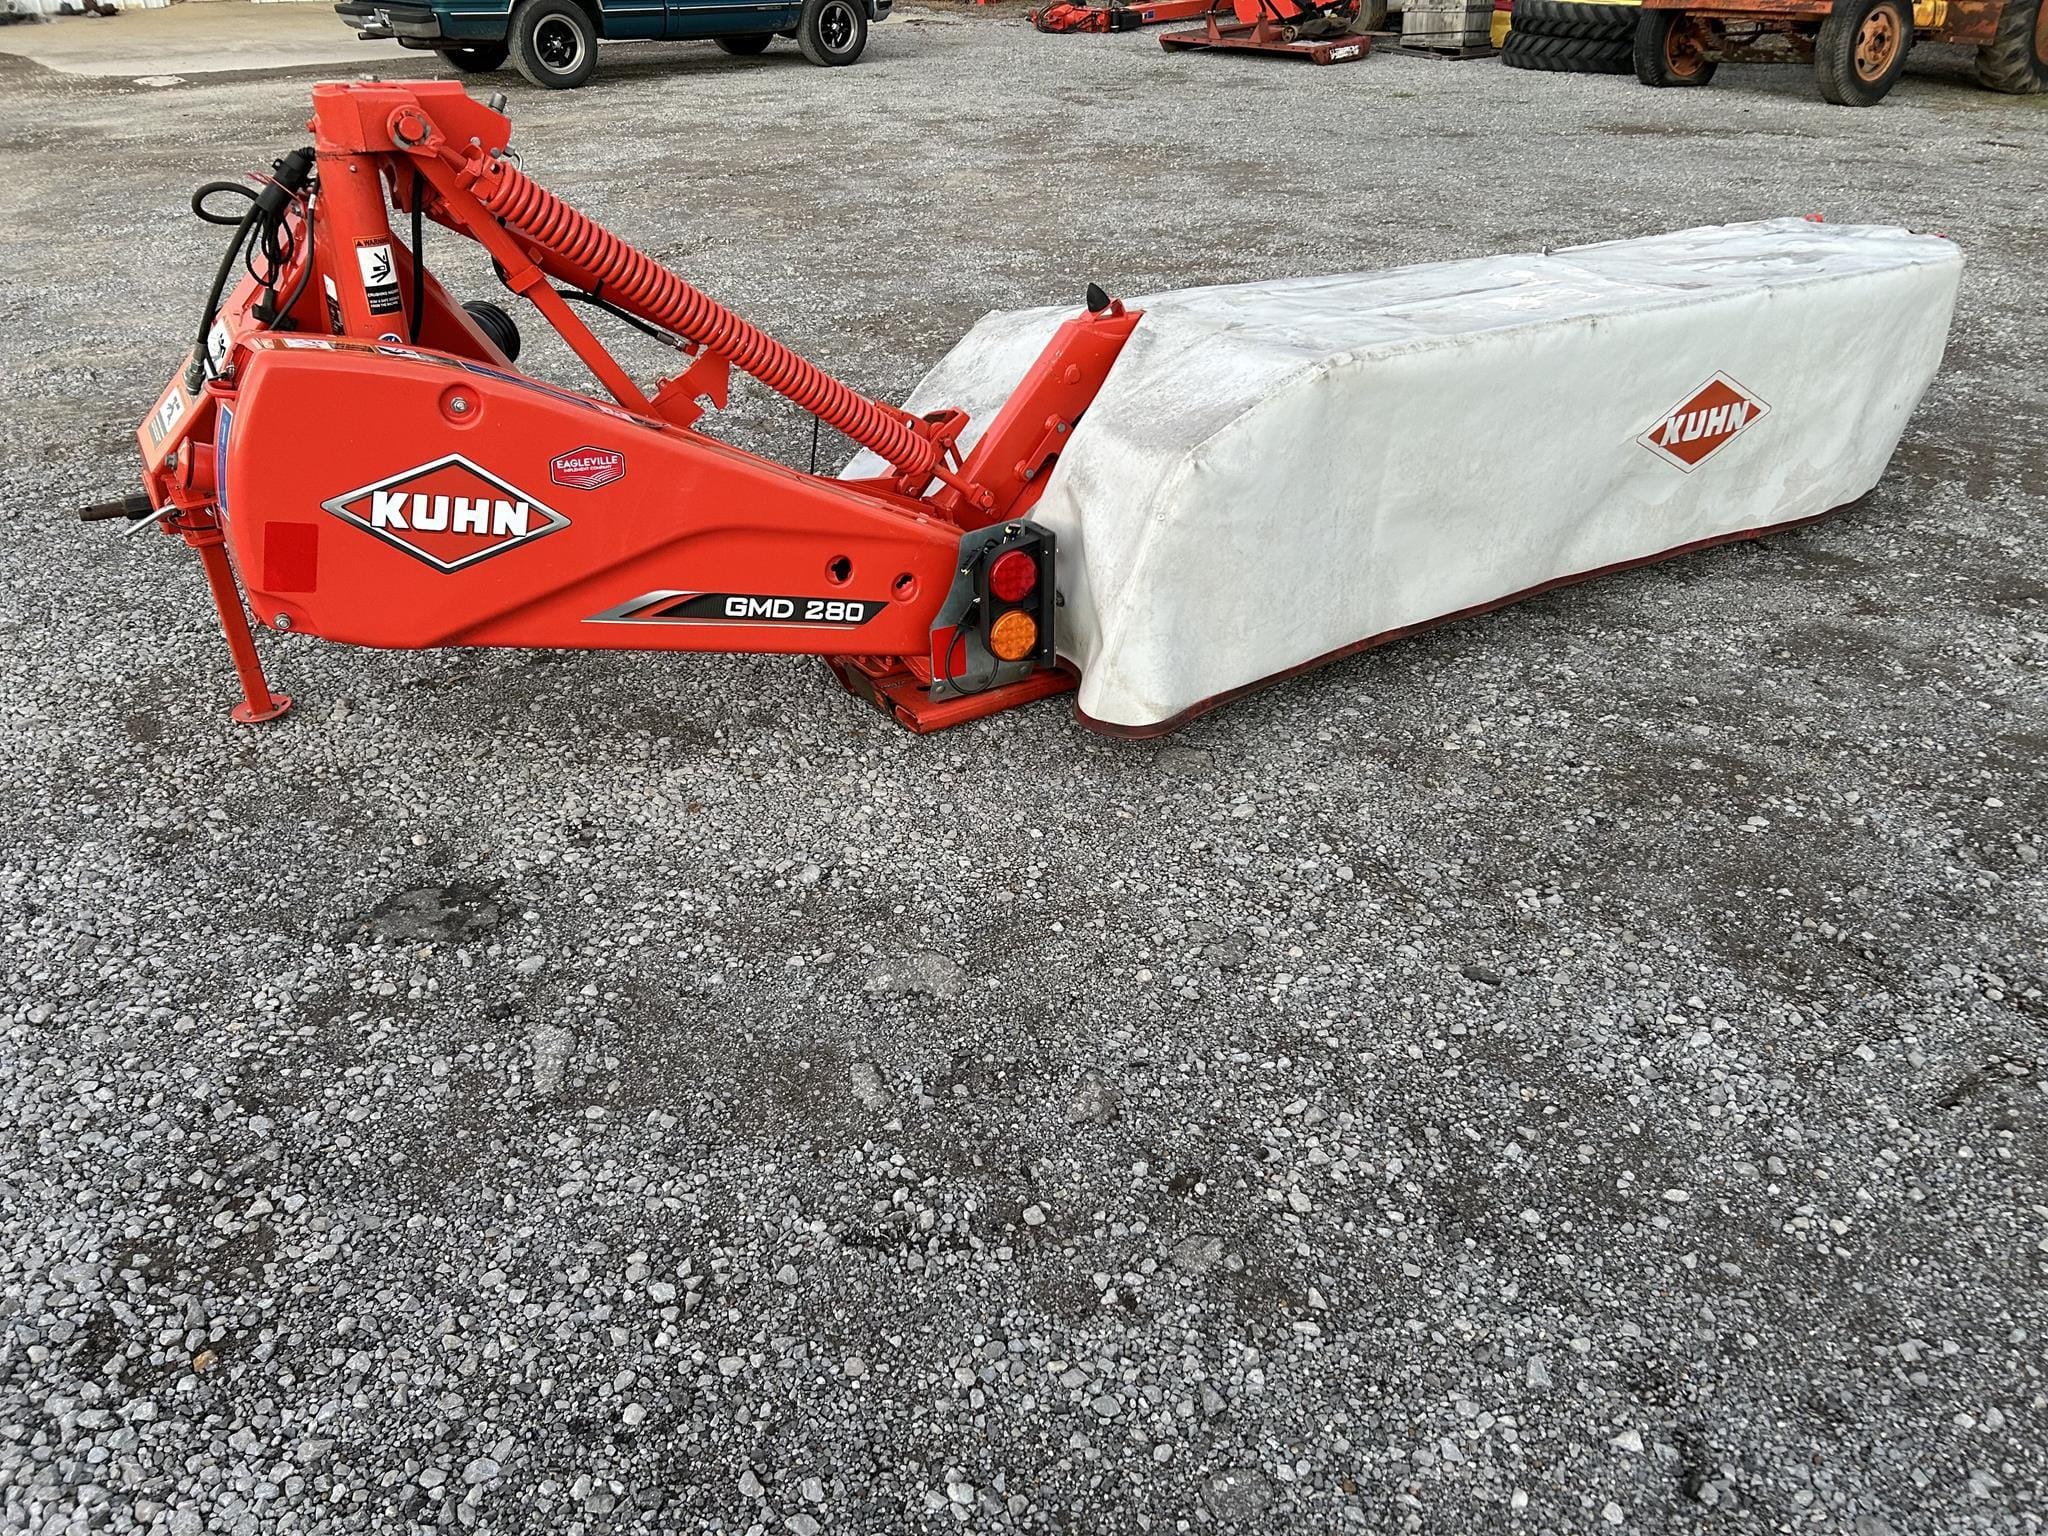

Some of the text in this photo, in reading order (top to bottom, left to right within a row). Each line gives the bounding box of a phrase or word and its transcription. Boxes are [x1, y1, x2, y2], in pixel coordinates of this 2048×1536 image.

[1659, 399, 1751, 447] KUHN
[556, 455, 618, 469] EAGLEVILLE
[370, 490, 530, 537] KUHN
[725, 597, 865, 622] GMD 280
